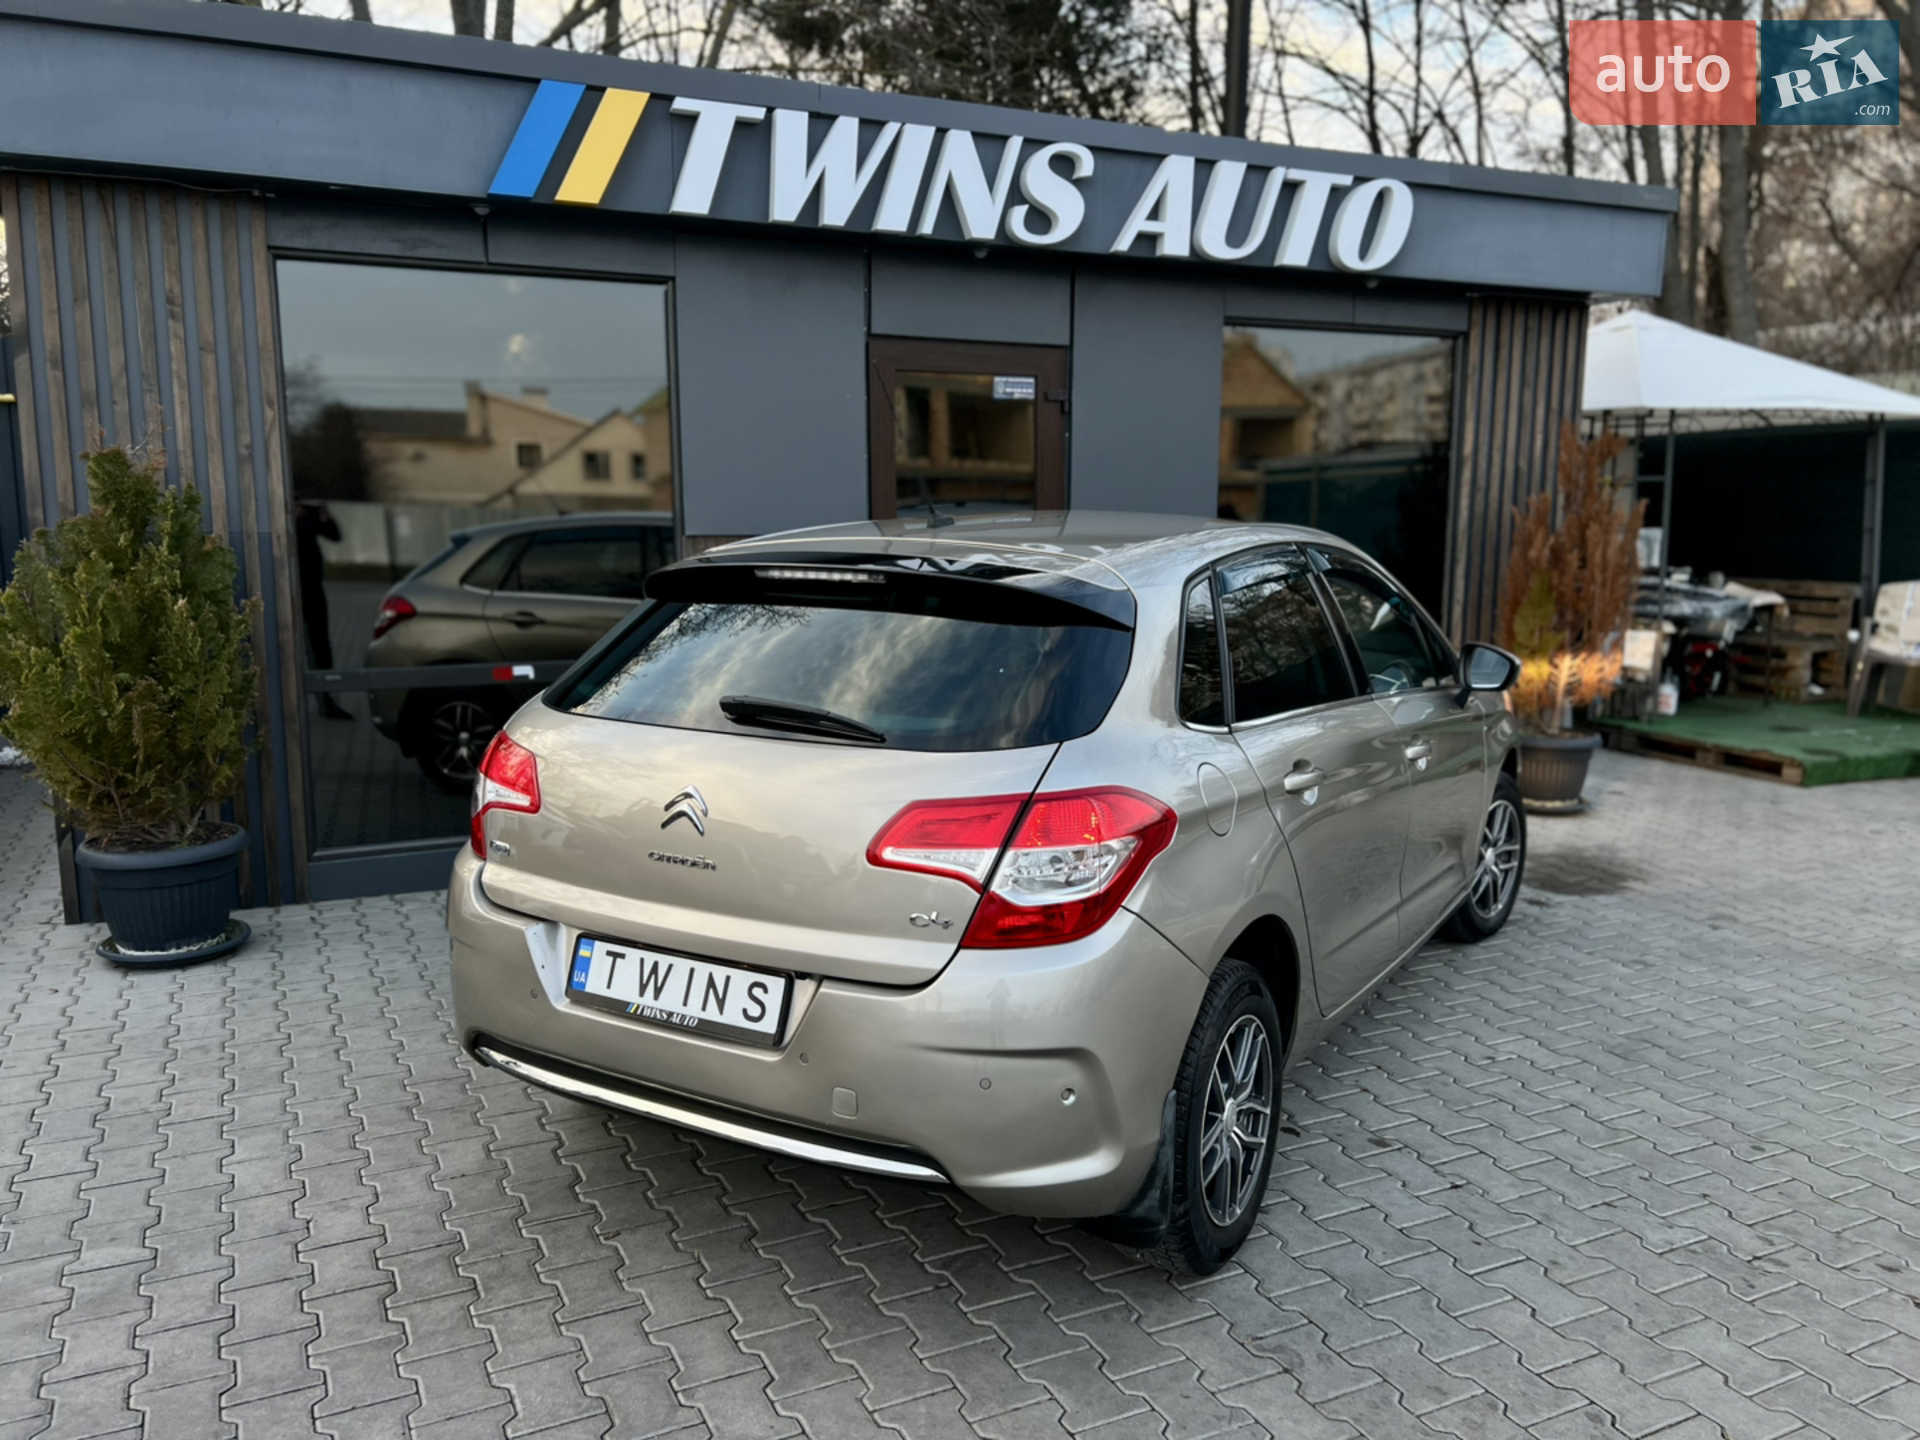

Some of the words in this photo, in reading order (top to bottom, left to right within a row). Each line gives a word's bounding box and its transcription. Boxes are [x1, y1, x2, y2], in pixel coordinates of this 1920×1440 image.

[668, 96, 1095, 246] TWINS
[1110, 154, 1414, 273] AUTO
[909, 911, 954, 930] C4
[573, 969, 586, 983] UA
[605, 950, 769, 1023] TWINS
[637, 1004, 669, 1021] TWINS
[669, 1012, 699, 1028] AUTO
